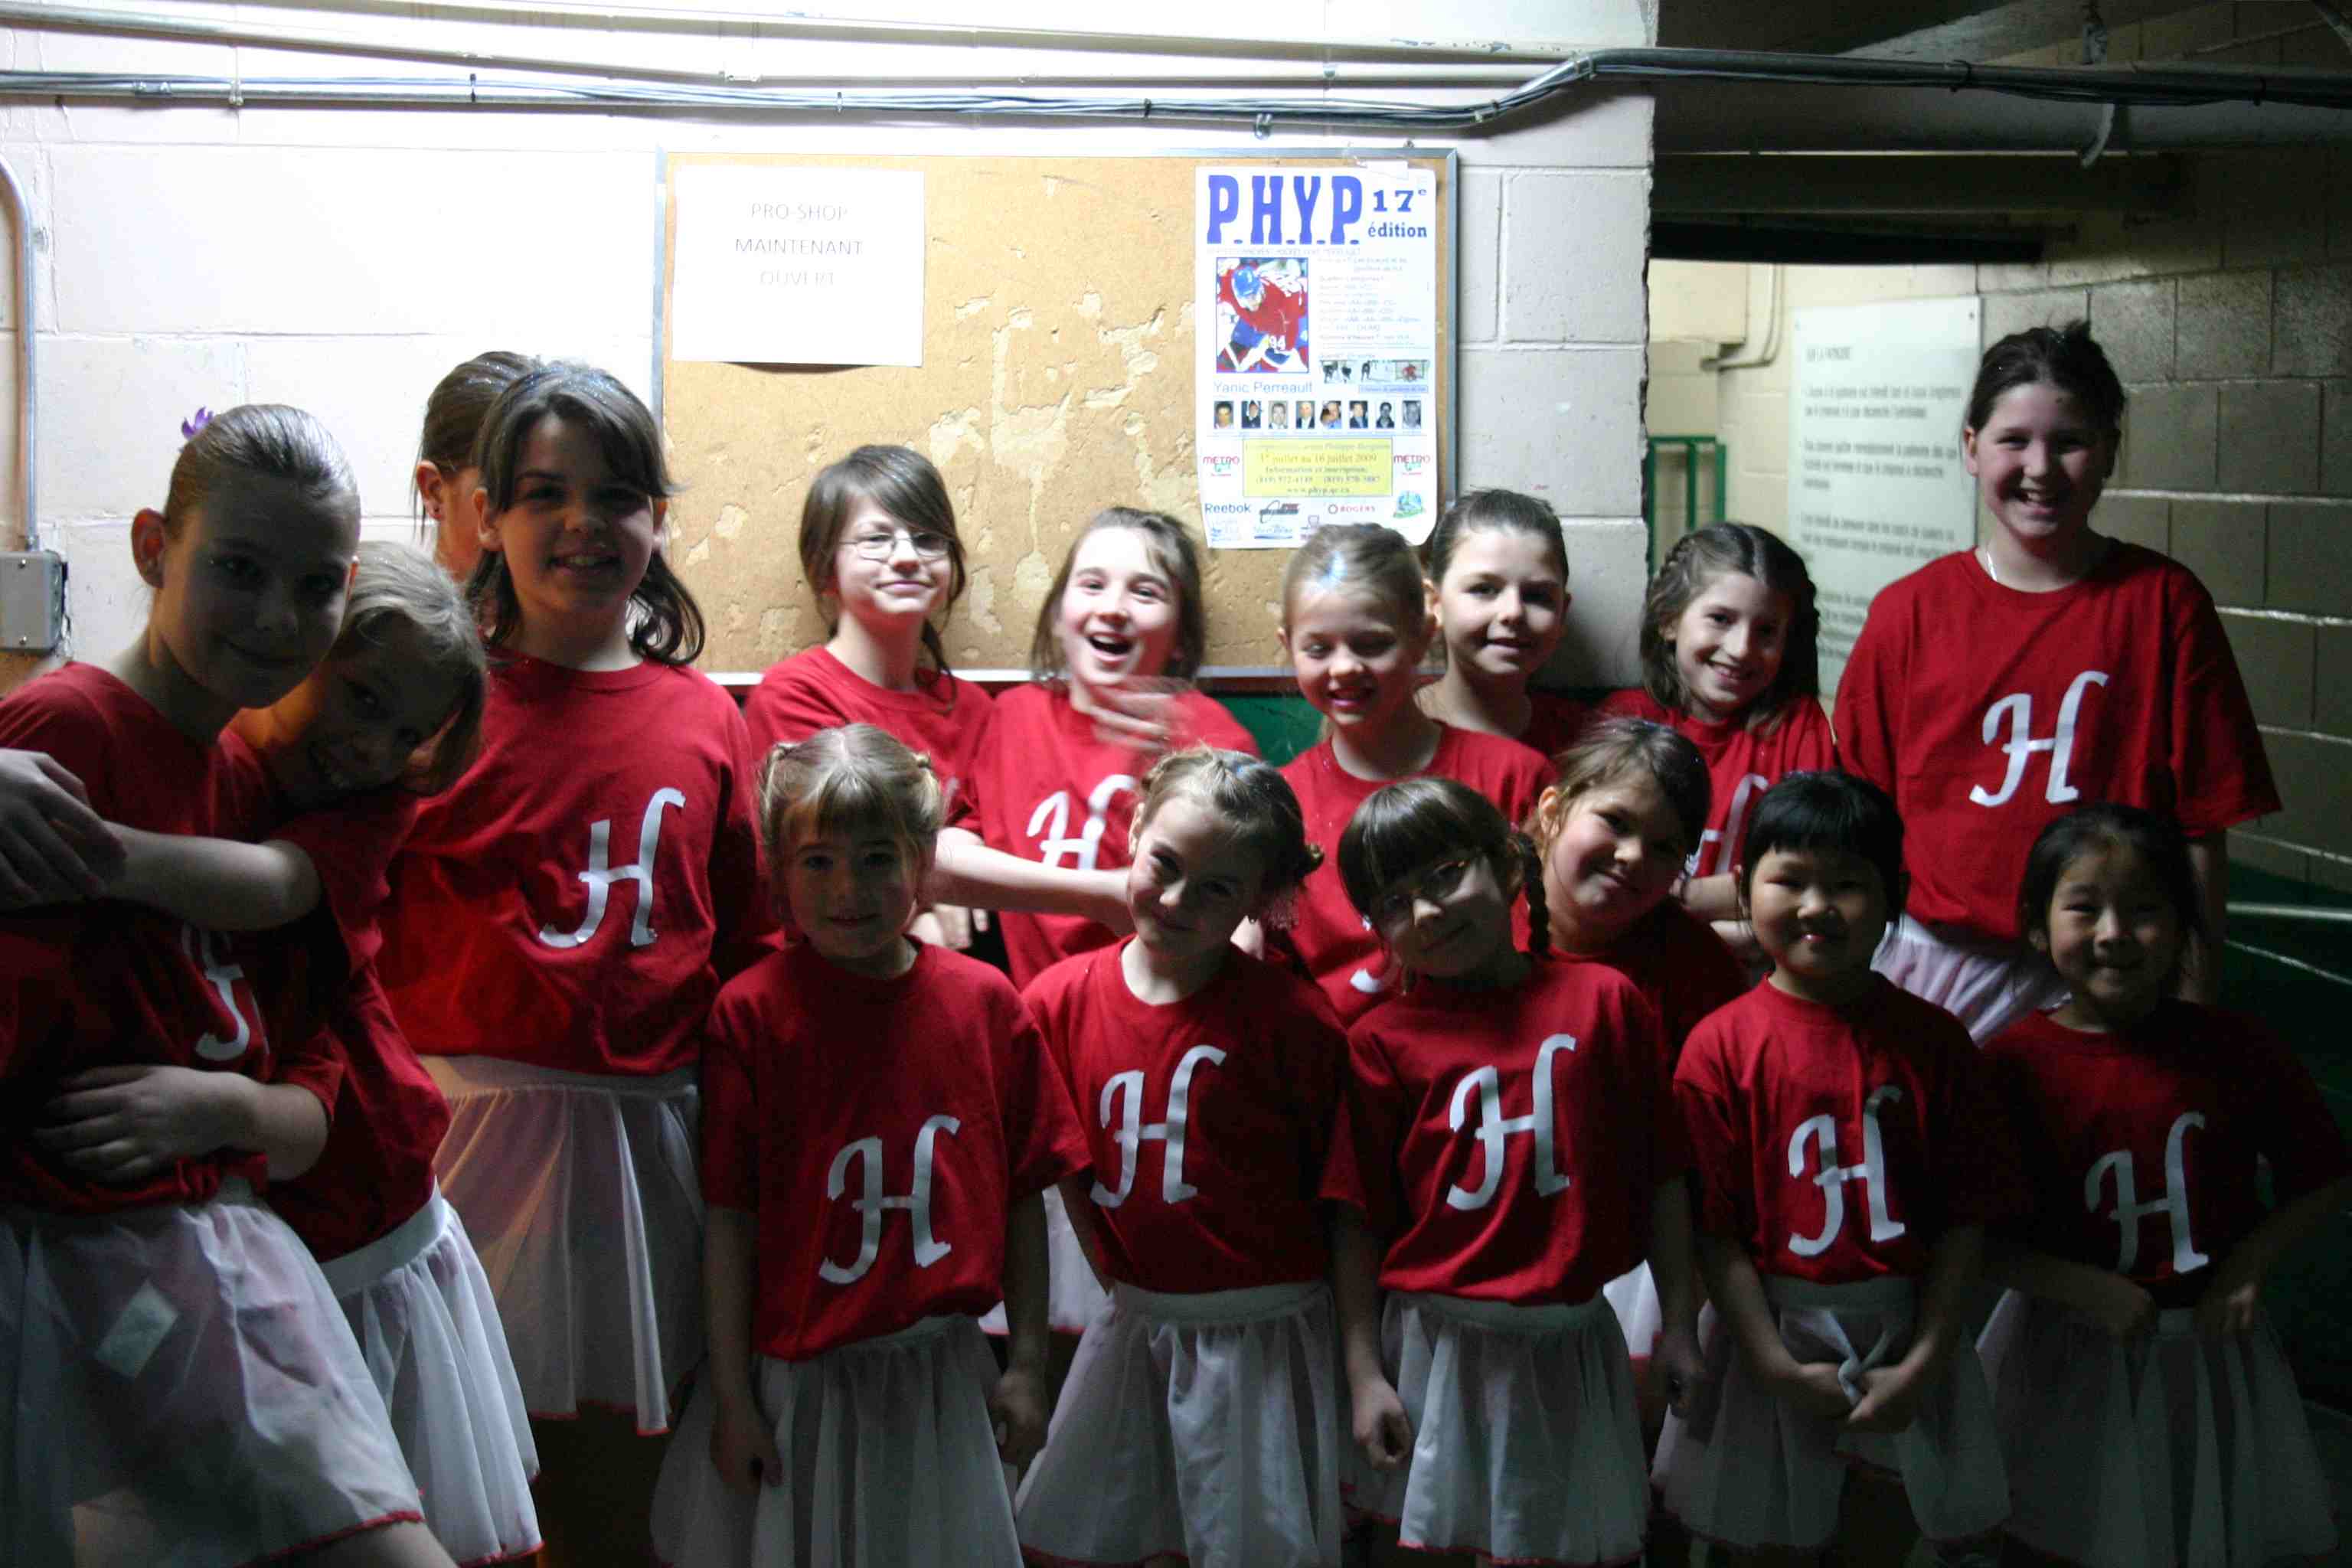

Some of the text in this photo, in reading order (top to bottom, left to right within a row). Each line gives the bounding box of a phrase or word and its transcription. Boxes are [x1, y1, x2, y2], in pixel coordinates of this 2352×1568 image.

[735, 238, 864, 256] MAINTENANT
[1367, 220, 1428, 239] édition
[1213, 381, 1314, 394] Yanic Perreault
[1204, 502, 1251, 514] Reebok
[1340, 504, 1376, 512] ROGERS
[1968, 670, 2110, 808] H
[539, 787, 684, 949] H
[1090, 1044, 1227, 1209] H
[1446, 1034, 1577, 1212] H
[1788, 1083, 1906, 1258] H
[2085, 1112, 2210, 1276] H
[818, 1114, 962, 1285] H
